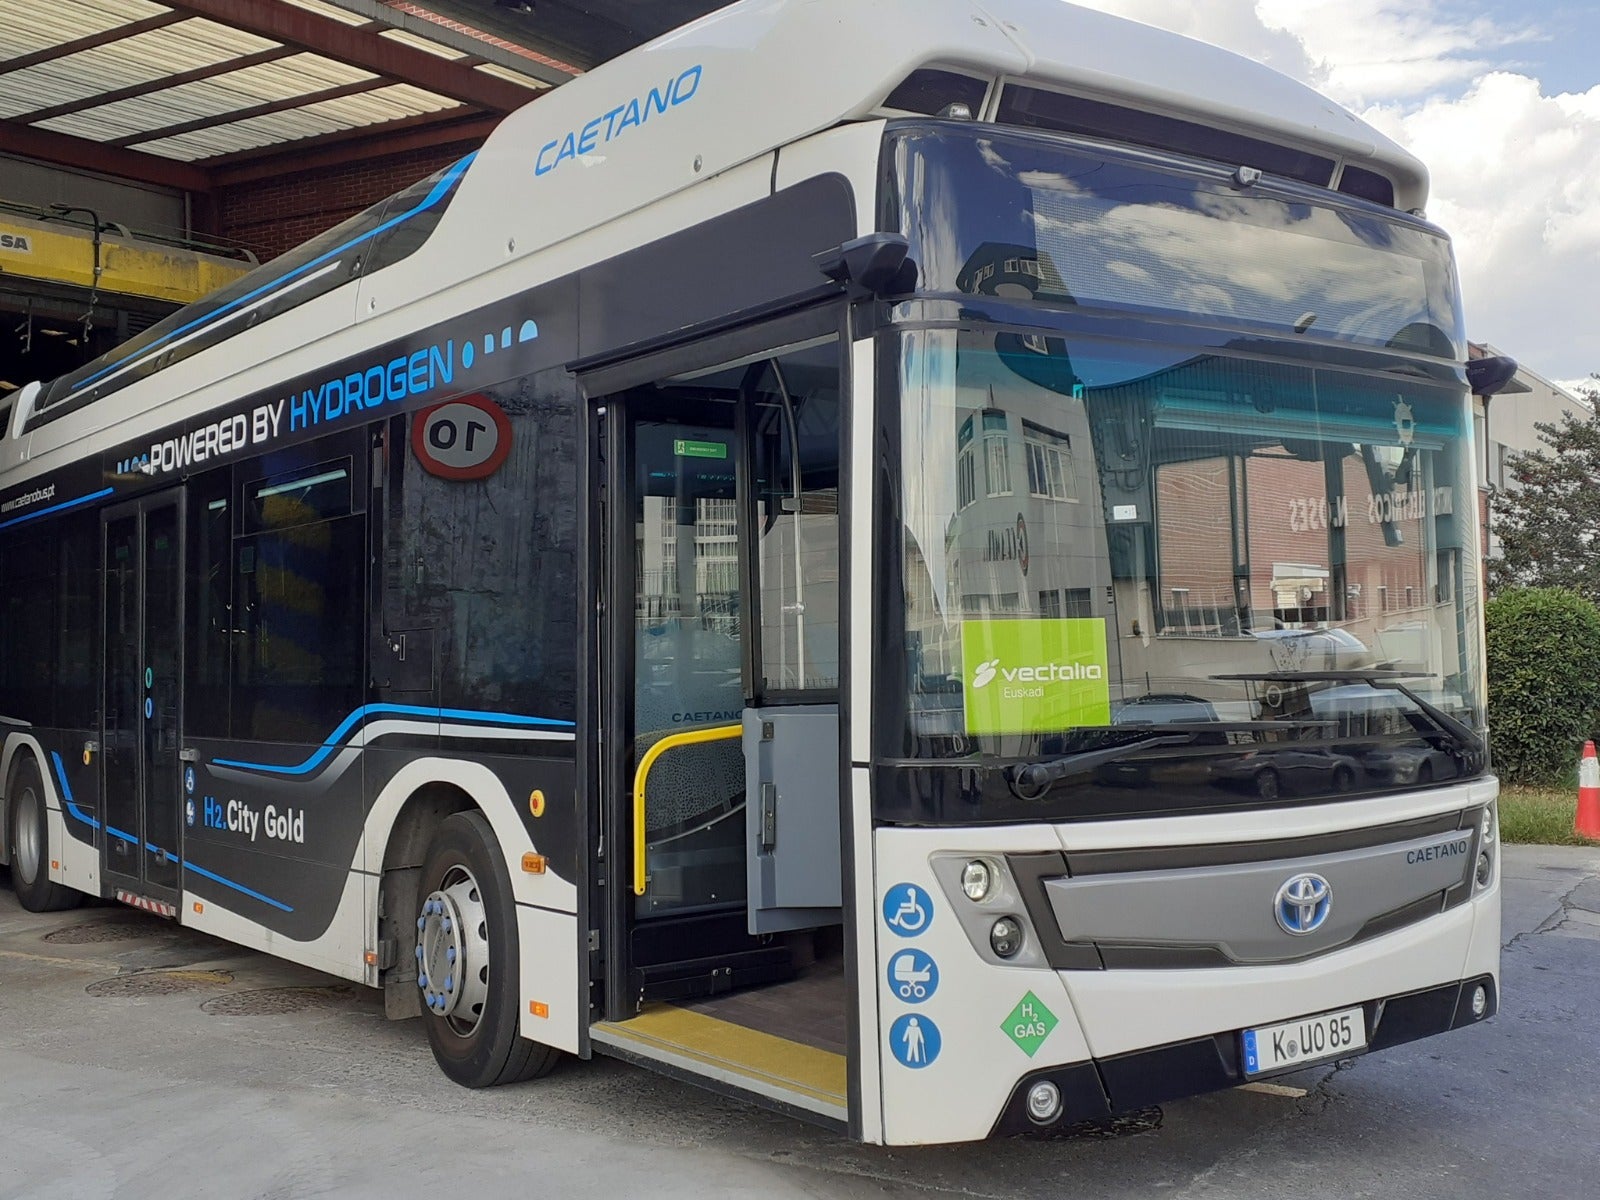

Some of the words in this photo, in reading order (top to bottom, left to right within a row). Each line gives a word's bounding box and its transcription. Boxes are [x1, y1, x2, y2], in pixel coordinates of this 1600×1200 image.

[534, 64, 702, 176] CAETANO
[149, 413, 248, 476] POWERED
[252, 399, 285, 444] BY
[289, 340, 454, 432] HYDROGEN
[1001, 662, 1102, 682] vectalia
[1003, 687, 1045, 698] Euskadi
[264, 804, 304, 844] Gold
[1406, 841, 1467, 865] CAETANO
[1014, 1022, 1046, 1039] GAS
[1272, 1030, 1287, 1062] K
[1299, 1022, 1325, 1055] UO
[1329, 1015, 1352, 1048] 85
[1248, 1056, 1255, 1066] D
